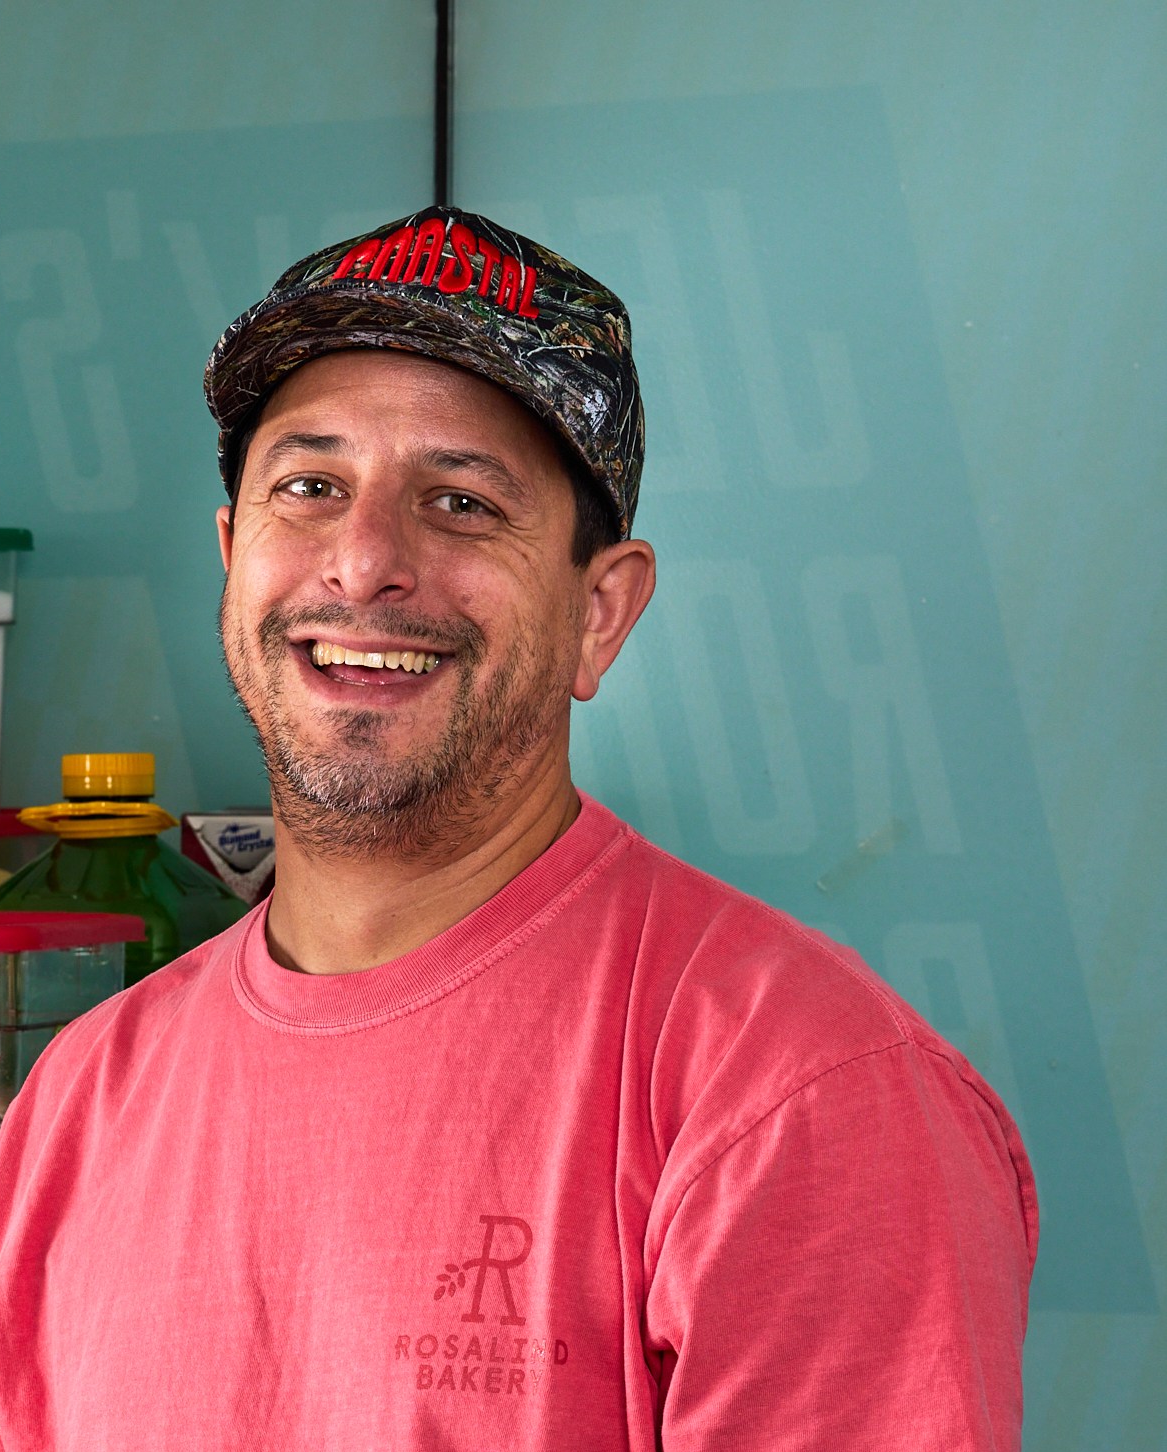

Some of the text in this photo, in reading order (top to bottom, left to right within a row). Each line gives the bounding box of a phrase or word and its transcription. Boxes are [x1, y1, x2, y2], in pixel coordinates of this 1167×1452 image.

[333, 218, 540, 319] COASTAL
[395, 1333, 569, 1366] ROSALIND
[416, 1364, 544, 1395] BAKERY
